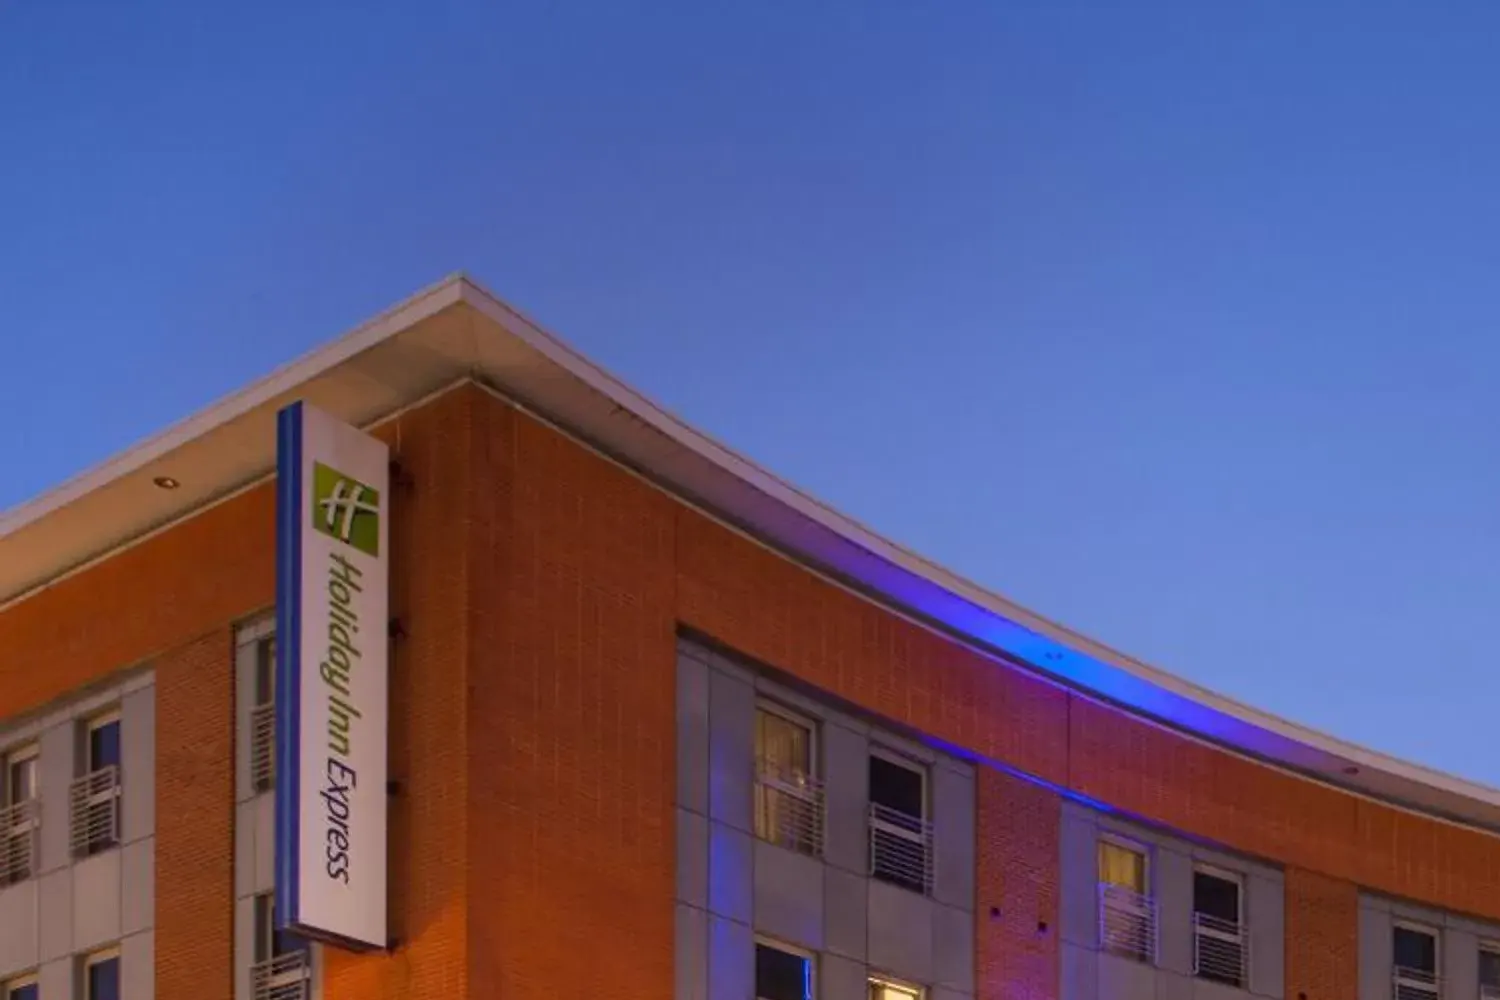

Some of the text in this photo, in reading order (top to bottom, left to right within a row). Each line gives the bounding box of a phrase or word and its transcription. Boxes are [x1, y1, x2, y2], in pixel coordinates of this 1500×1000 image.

[319, 552, 364, 885] Holiday Inn Express
